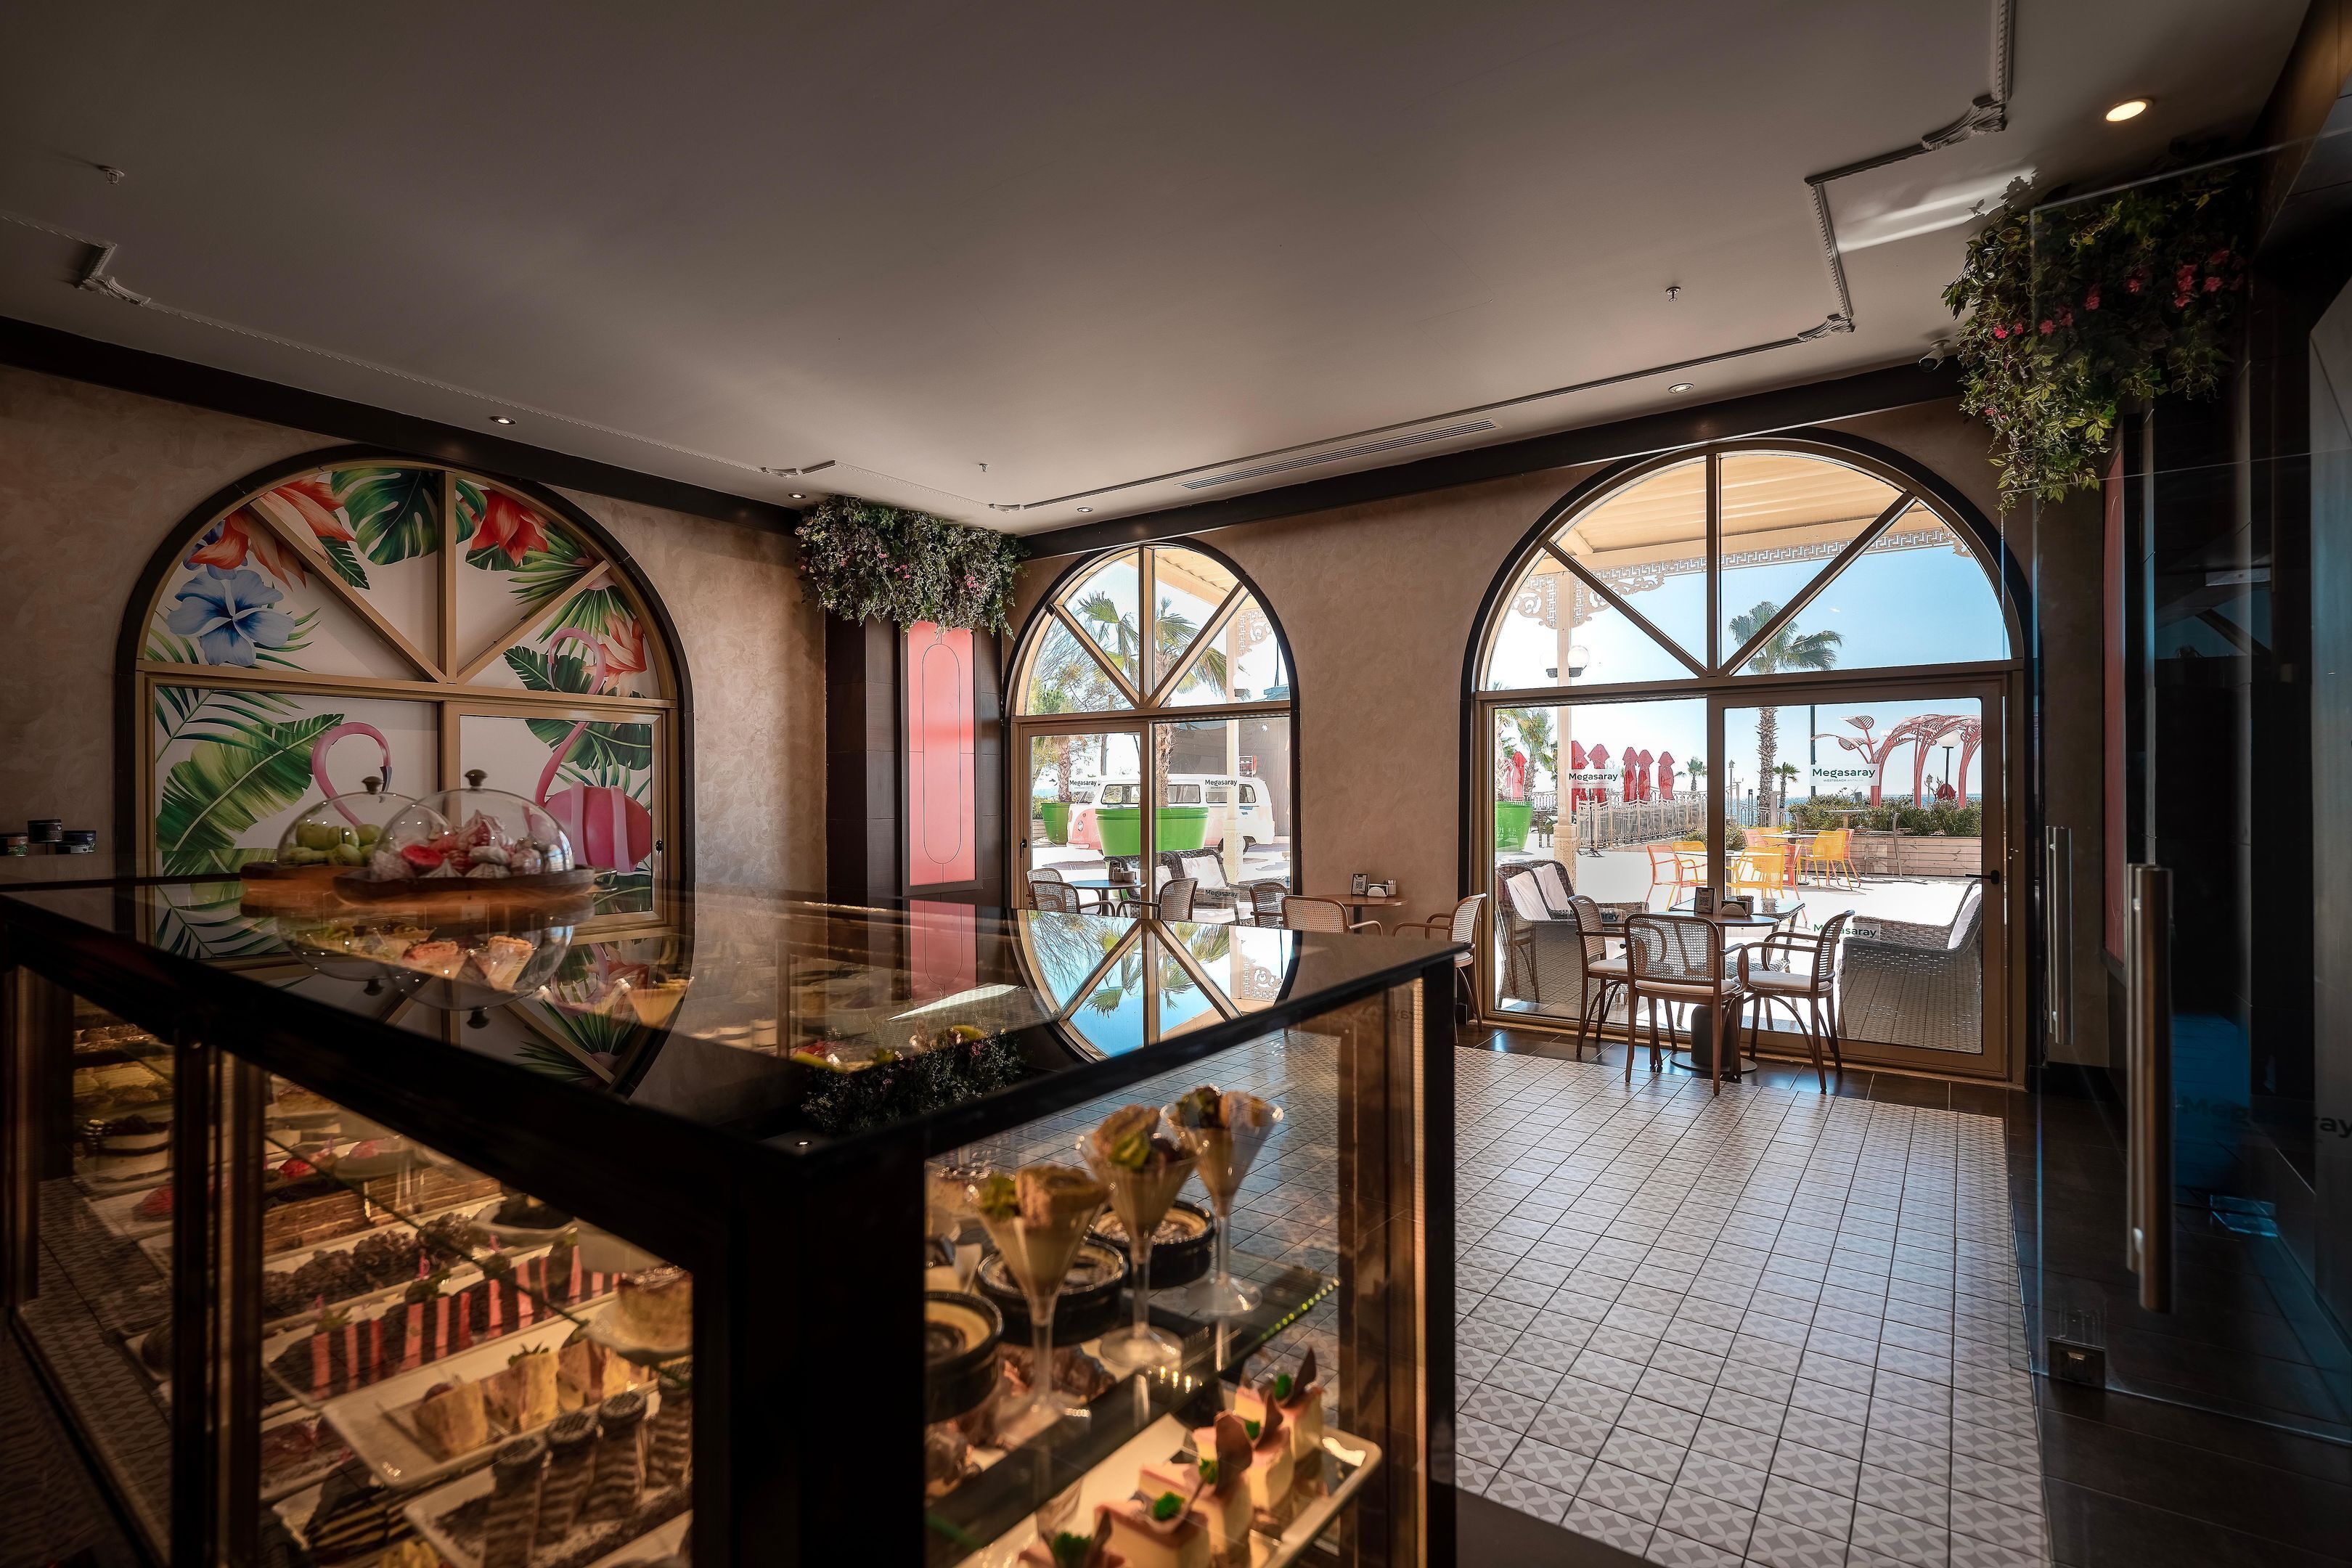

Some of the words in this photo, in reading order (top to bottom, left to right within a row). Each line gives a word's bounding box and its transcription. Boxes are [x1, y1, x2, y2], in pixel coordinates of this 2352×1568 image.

[1569, 772, 1618, 782] Megasaray
[1812, 768, 1876, 778] Megasaray
[1205, 889, 1238, 898] Megasaray
[1813, 923, 1877, 938] Masaray
